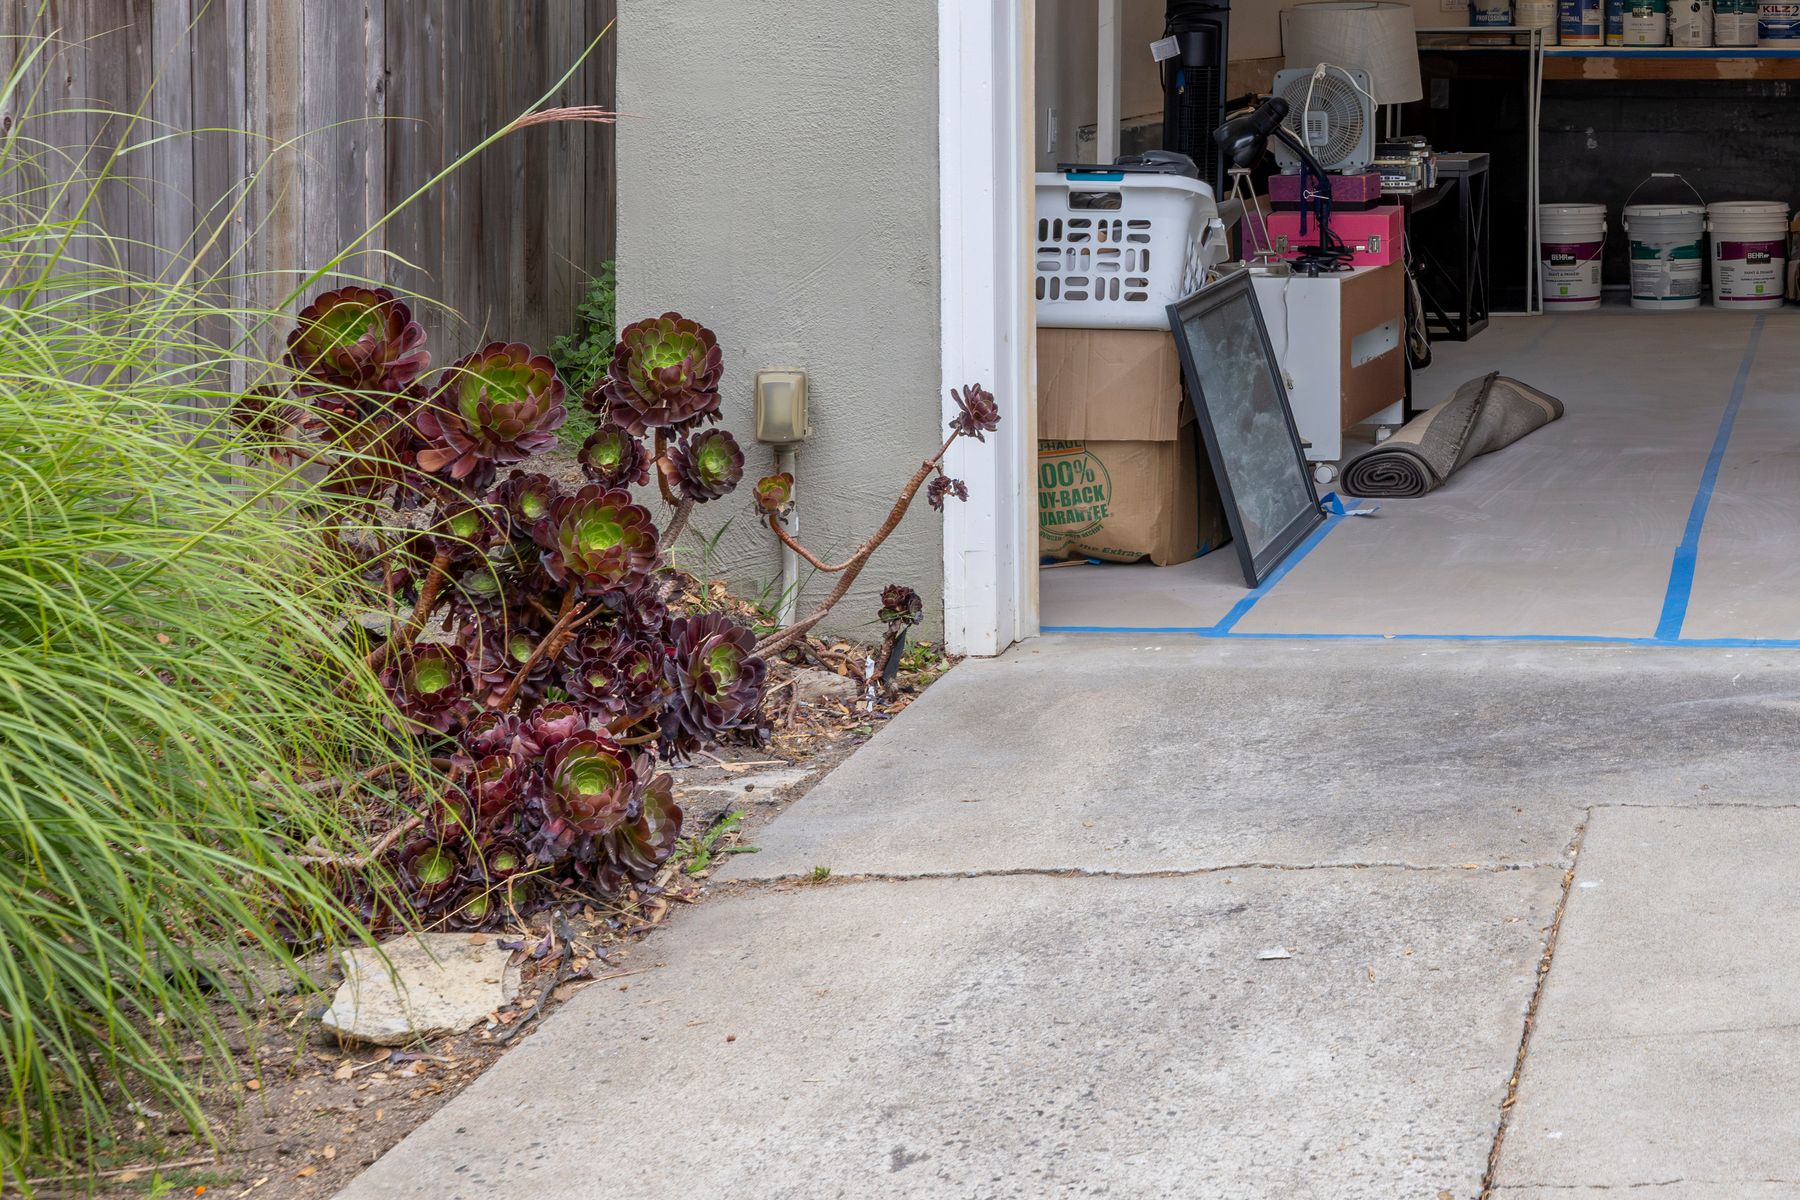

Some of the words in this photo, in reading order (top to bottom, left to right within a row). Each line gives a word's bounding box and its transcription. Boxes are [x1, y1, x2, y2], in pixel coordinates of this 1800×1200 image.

[1763, 5, 1791, 13] KILZ
[1791, 5, 1800, 17] 2
[1039, 485, 1105, 509] UY-BACK
[1040, 504, 1109, 527] UARANTEE
